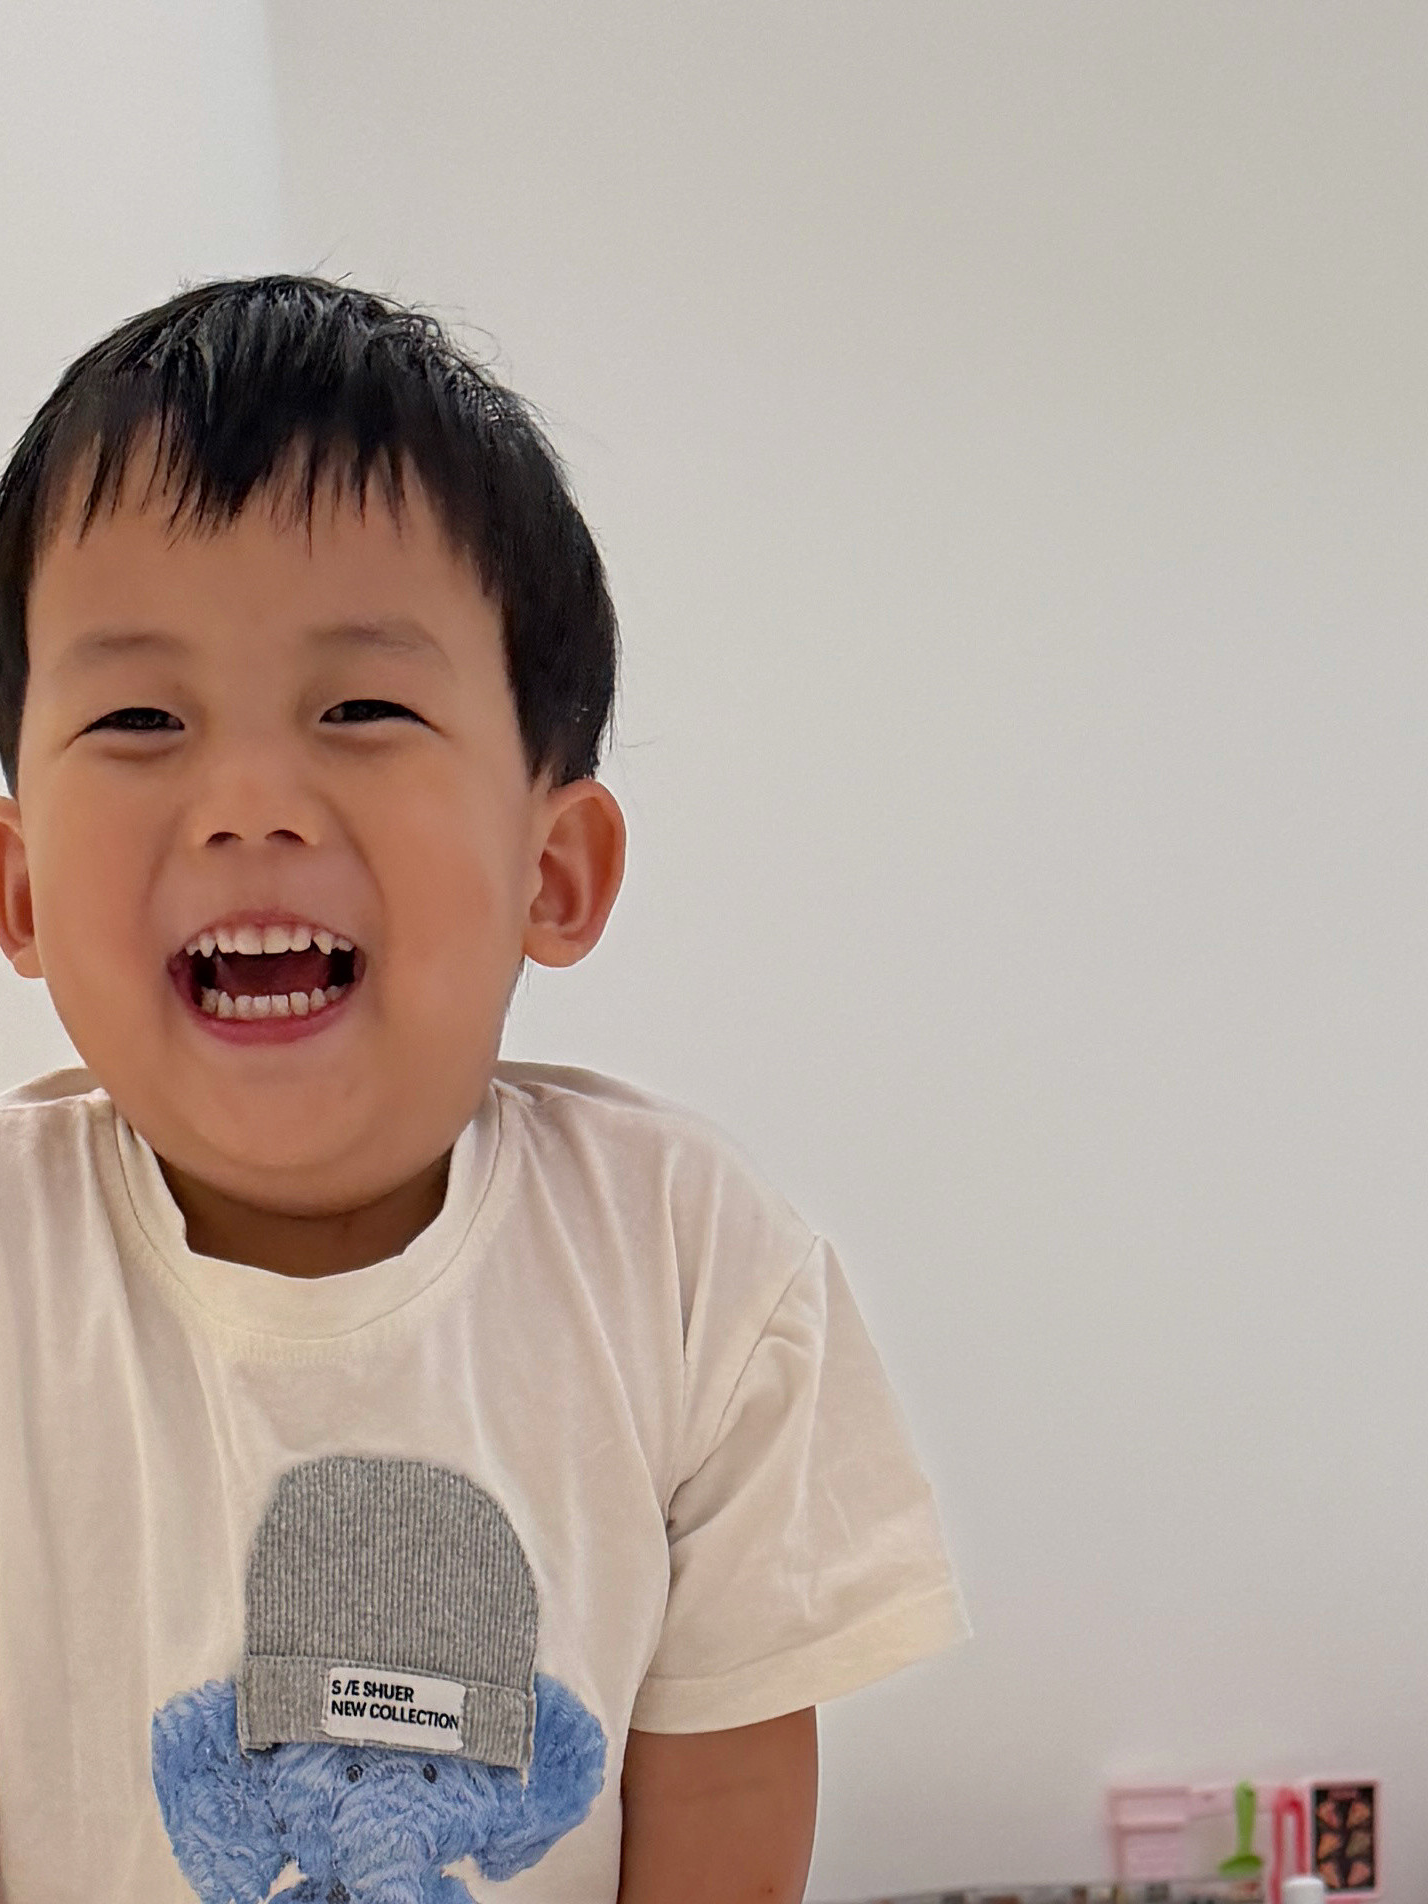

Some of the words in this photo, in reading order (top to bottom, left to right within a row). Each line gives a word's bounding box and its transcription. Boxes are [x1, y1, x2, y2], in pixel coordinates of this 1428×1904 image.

[363, 1681, 414, 1703] SHUER
[331, 1700, 366, 1718] NEW
[370, 1703, 459, 1730] COLLECTION
